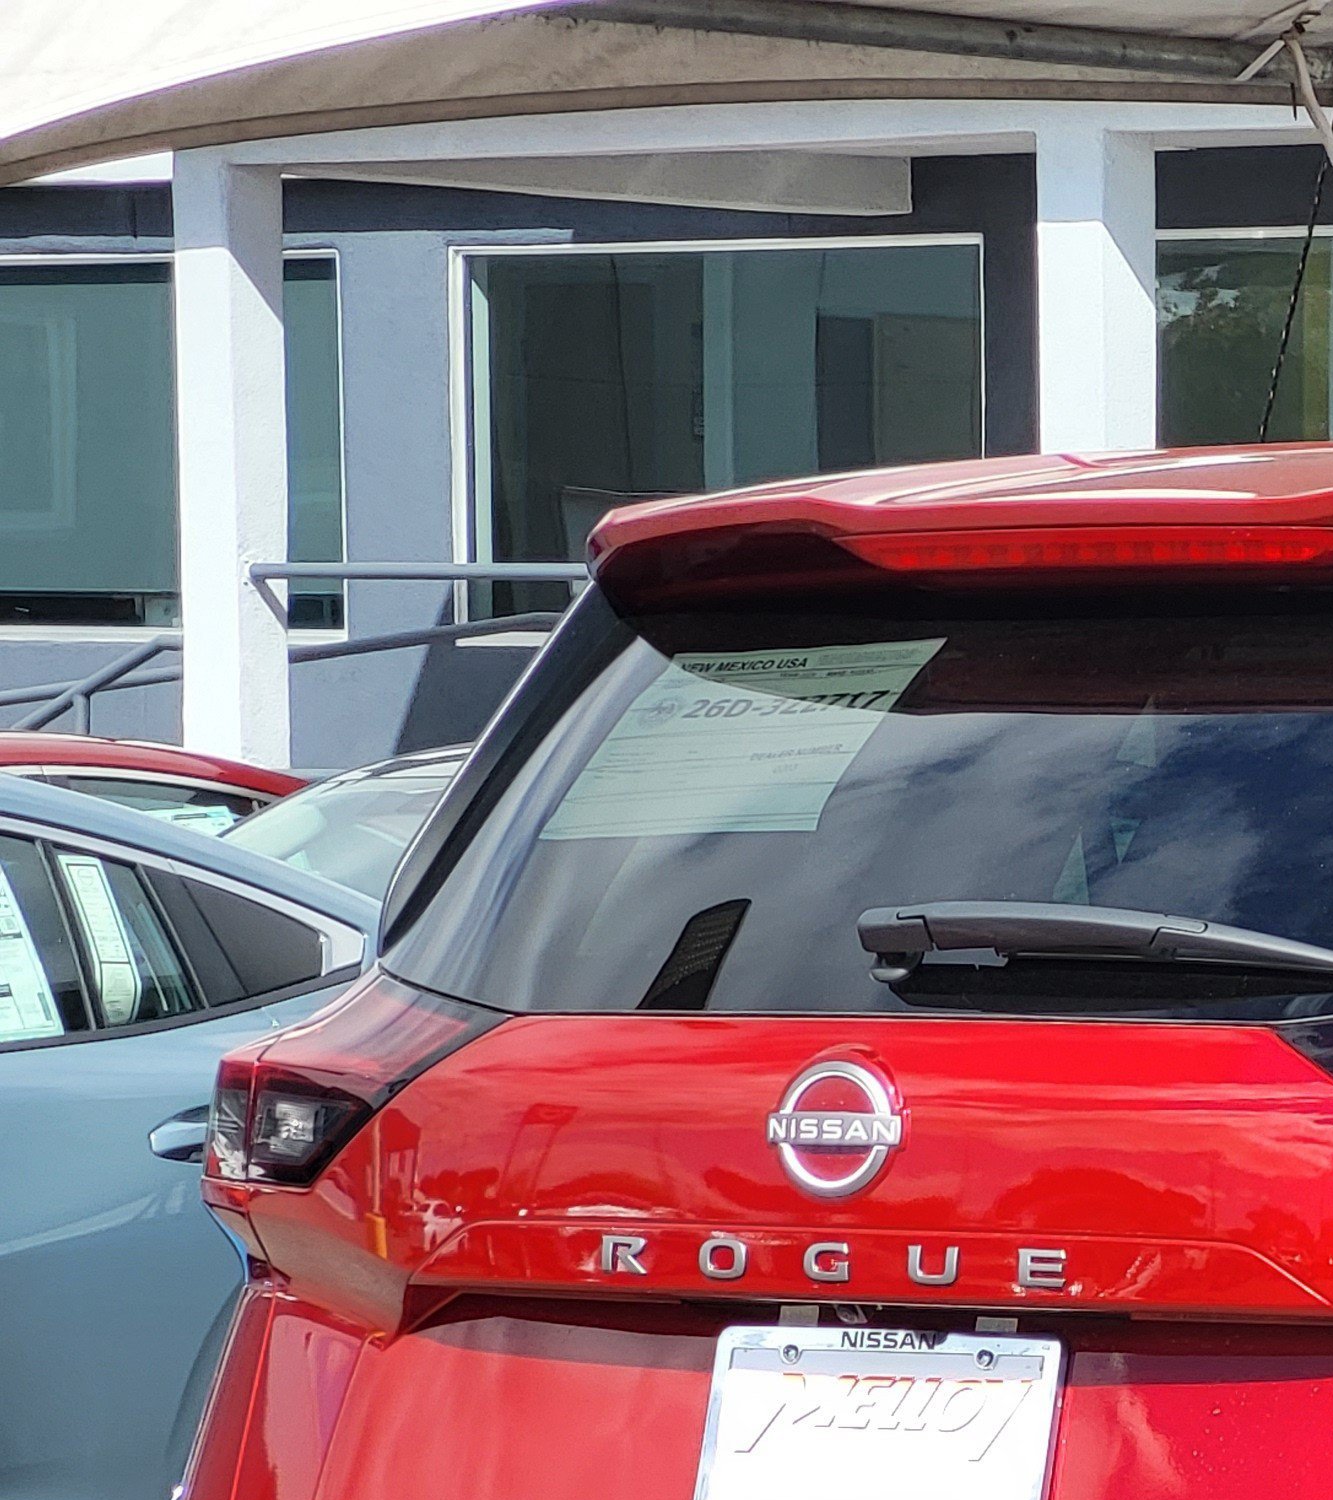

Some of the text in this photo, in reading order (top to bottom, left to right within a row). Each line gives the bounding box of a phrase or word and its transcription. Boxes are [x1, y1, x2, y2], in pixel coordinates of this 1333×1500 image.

[716, 658, 775, 672] MEXICO
[776, 657, 809, 669] USA
[767, 1117, 897, 1142] NISSAN
[601, 1234, 1068, 1289] ROGUE
[840, 1330, 937, 1351] NISSAN
